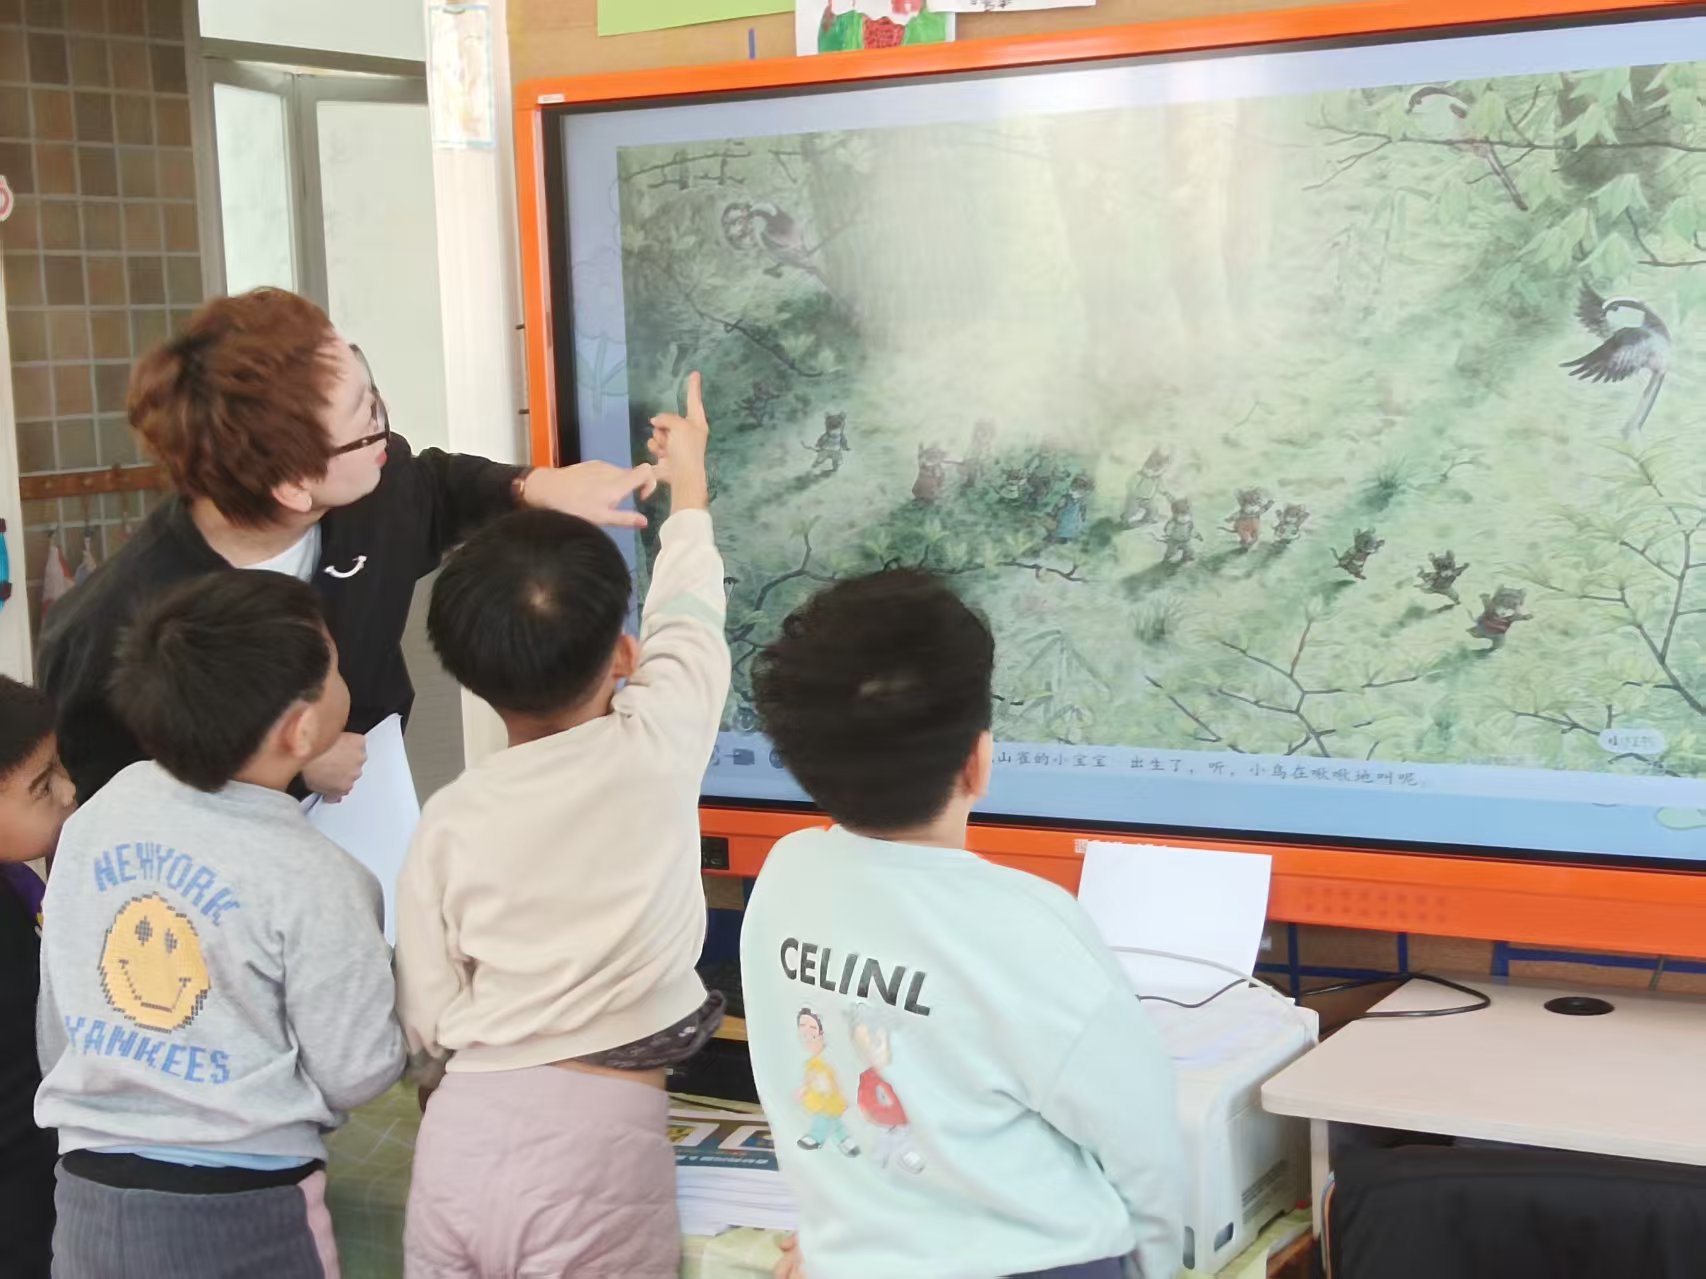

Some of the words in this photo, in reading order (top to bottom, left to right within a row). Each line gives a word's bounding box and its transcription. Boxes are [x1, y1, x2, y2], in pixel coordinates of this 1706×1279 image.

[991, 750, 1107, 768] 山雀的小宝宝
[780, 937, 930, 1016] CELINL
[65, 1015, 231, 1084] YANKEES
